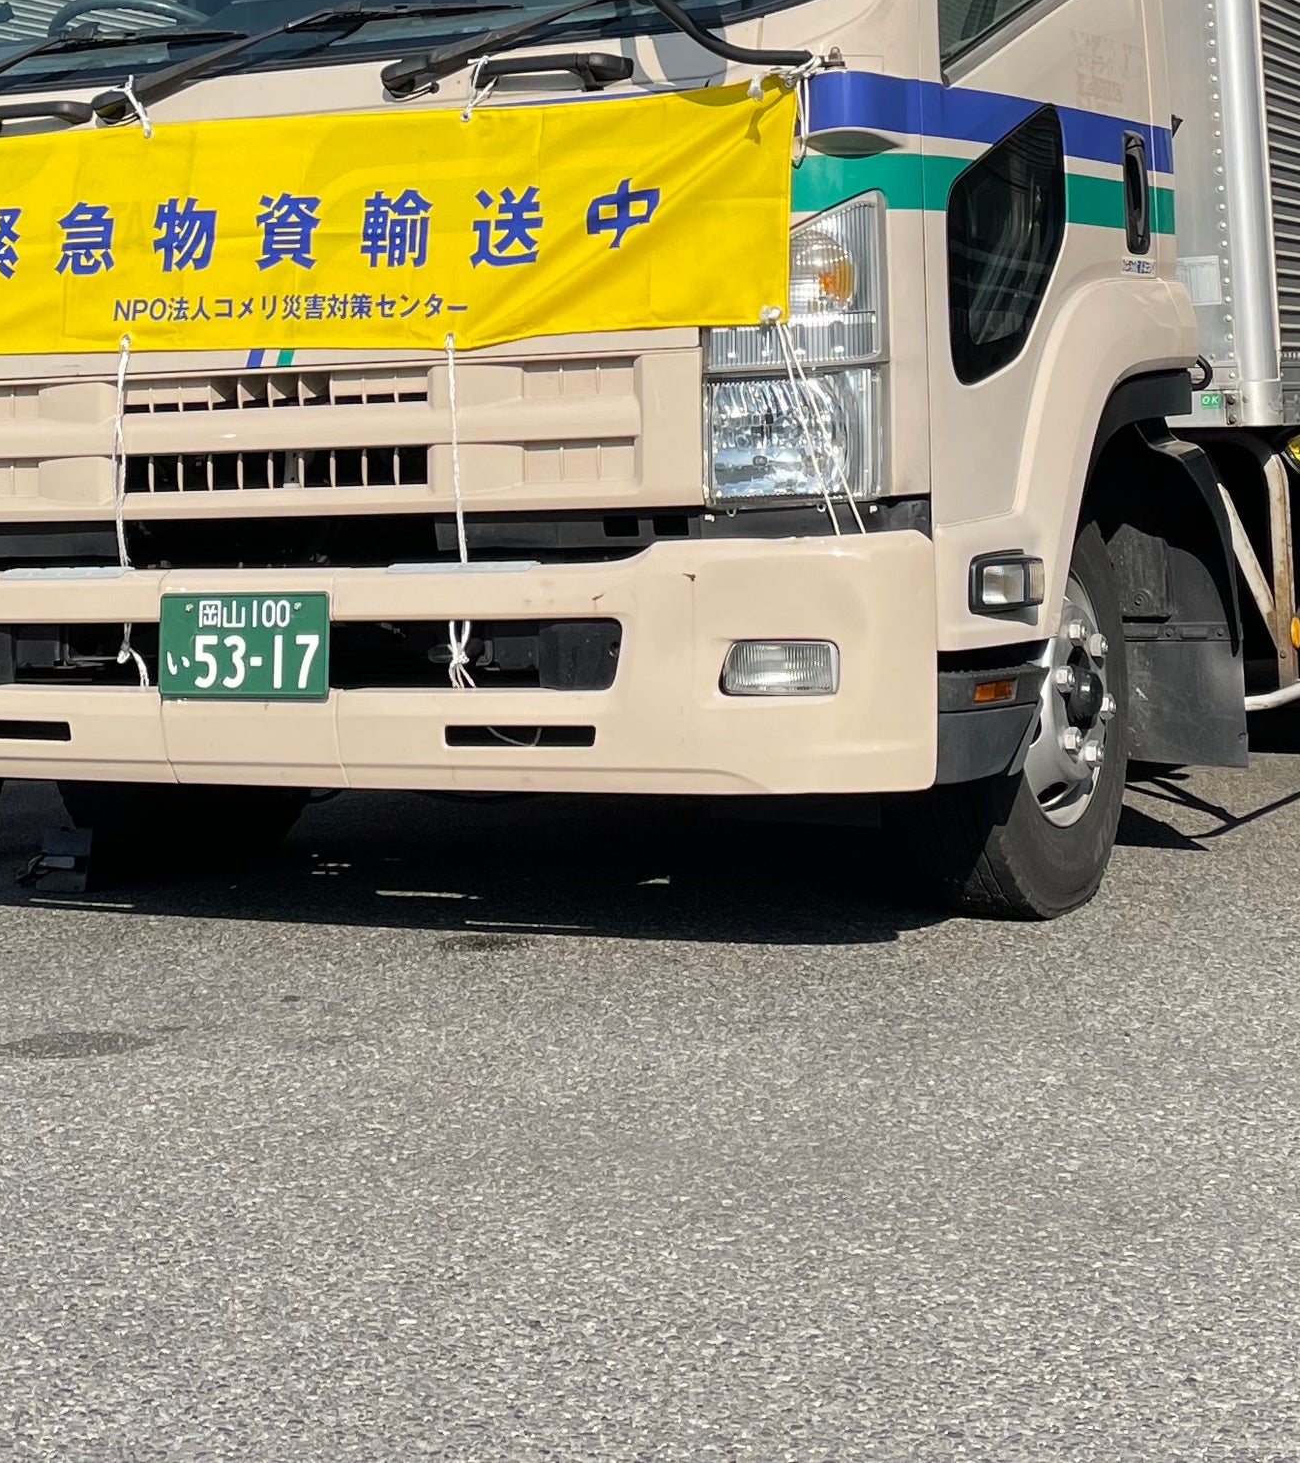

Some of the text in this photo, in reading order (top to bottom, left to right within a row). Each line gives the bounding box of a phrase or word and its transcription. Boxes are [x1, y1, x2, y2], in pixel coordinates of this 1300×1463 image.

[112, 293, 469, 322] NPO法人コメリ災害対策センター
[1201, 394, 1220, 405] OK
[194, 634, 320, 690] 53-17
